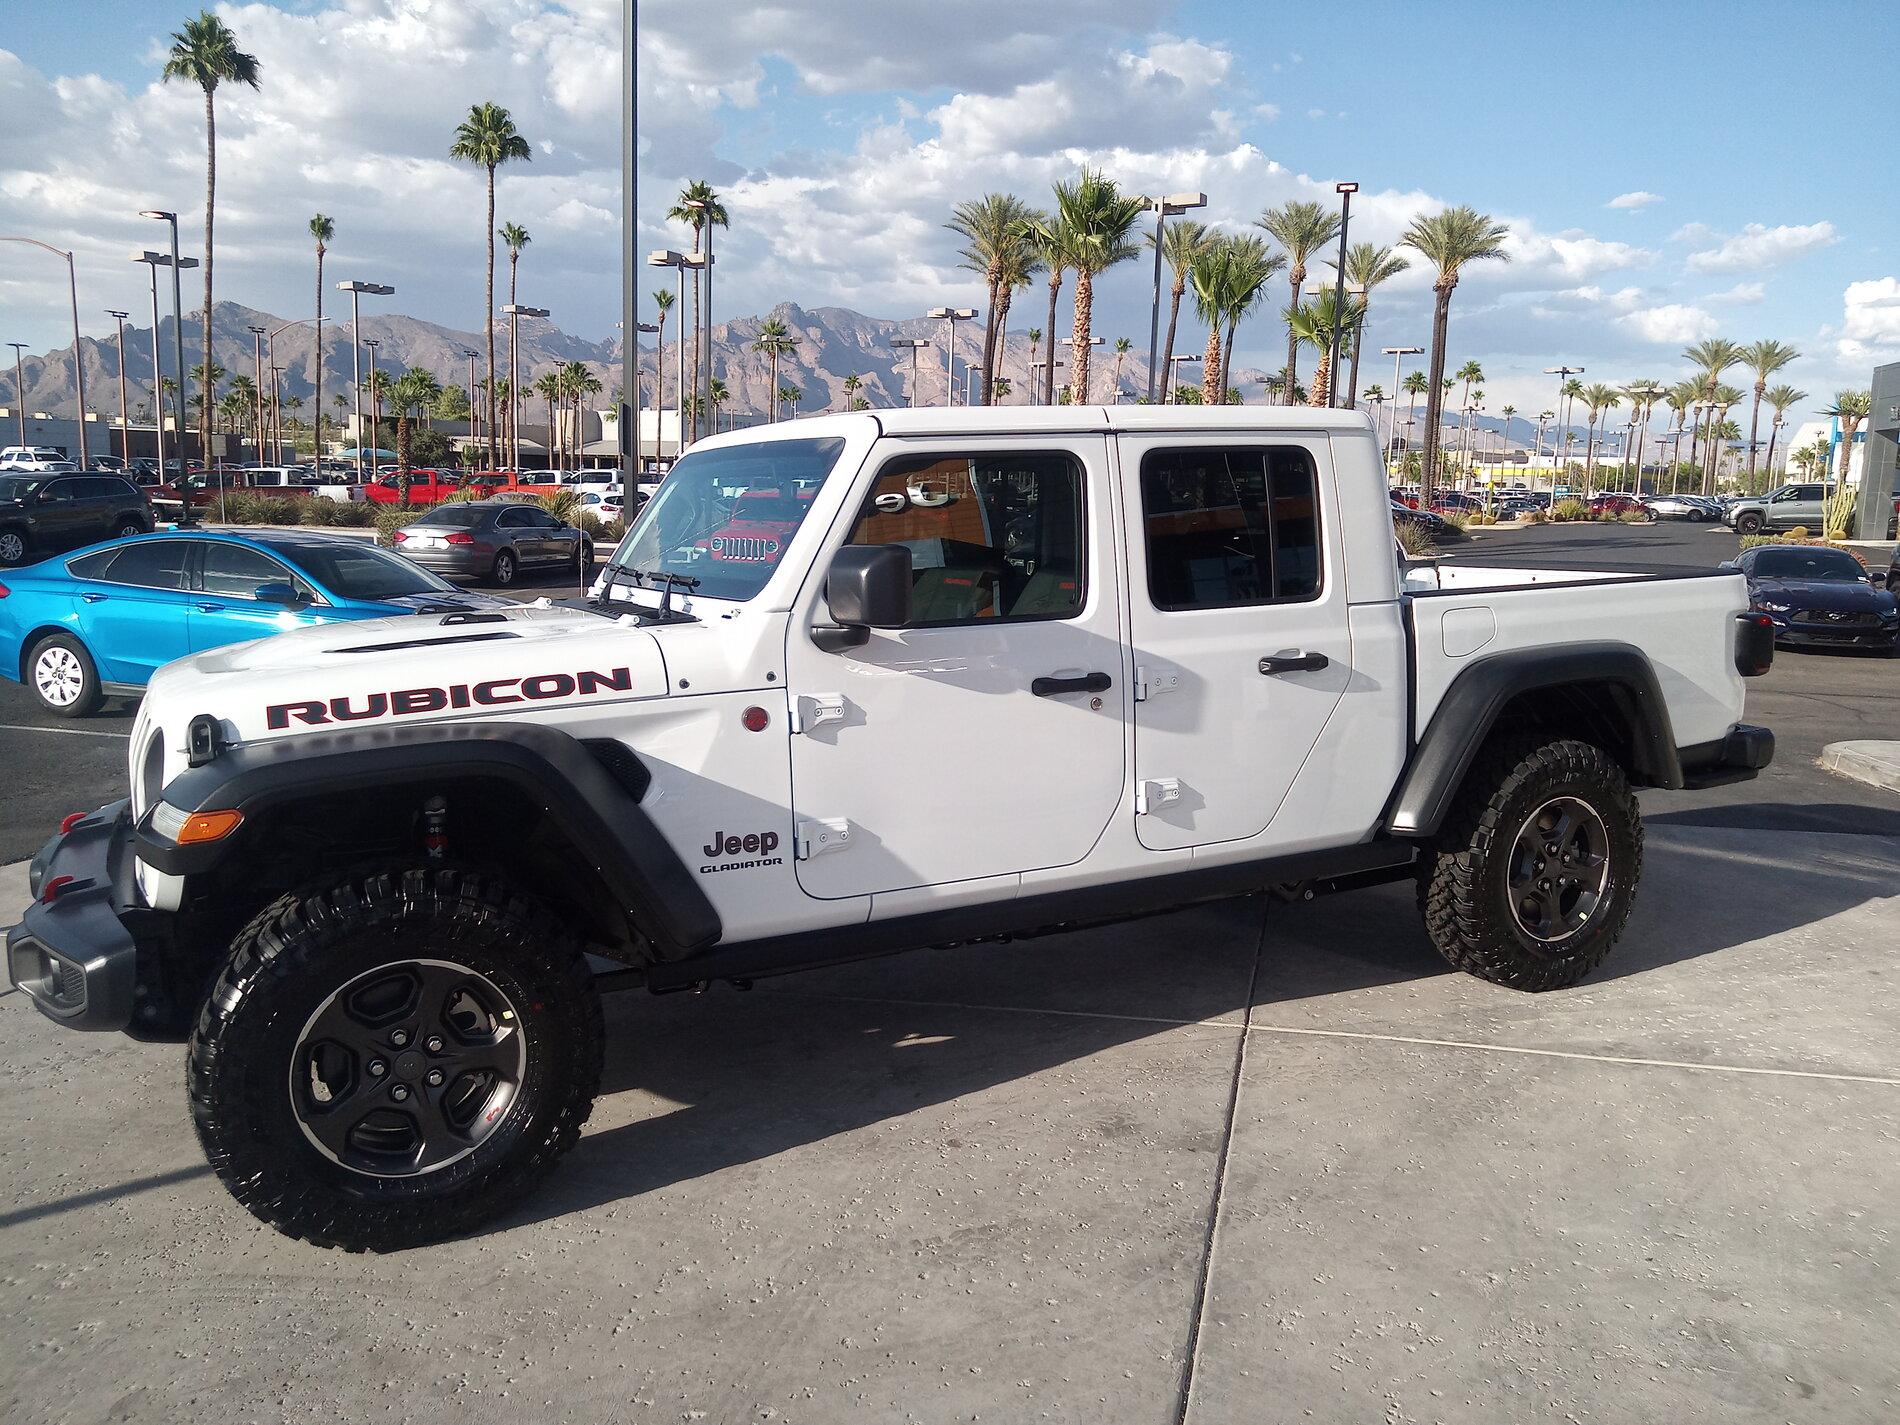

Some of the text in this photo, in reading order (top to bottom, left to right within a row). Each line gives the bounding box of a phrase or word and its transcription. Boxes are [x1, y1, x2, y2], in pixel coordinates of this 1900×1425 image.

[266, 667, 633, 730] RUBICON
[703, 831, 779, 857] Jeep
[700, 857, 783, 873] GLADIATOR
